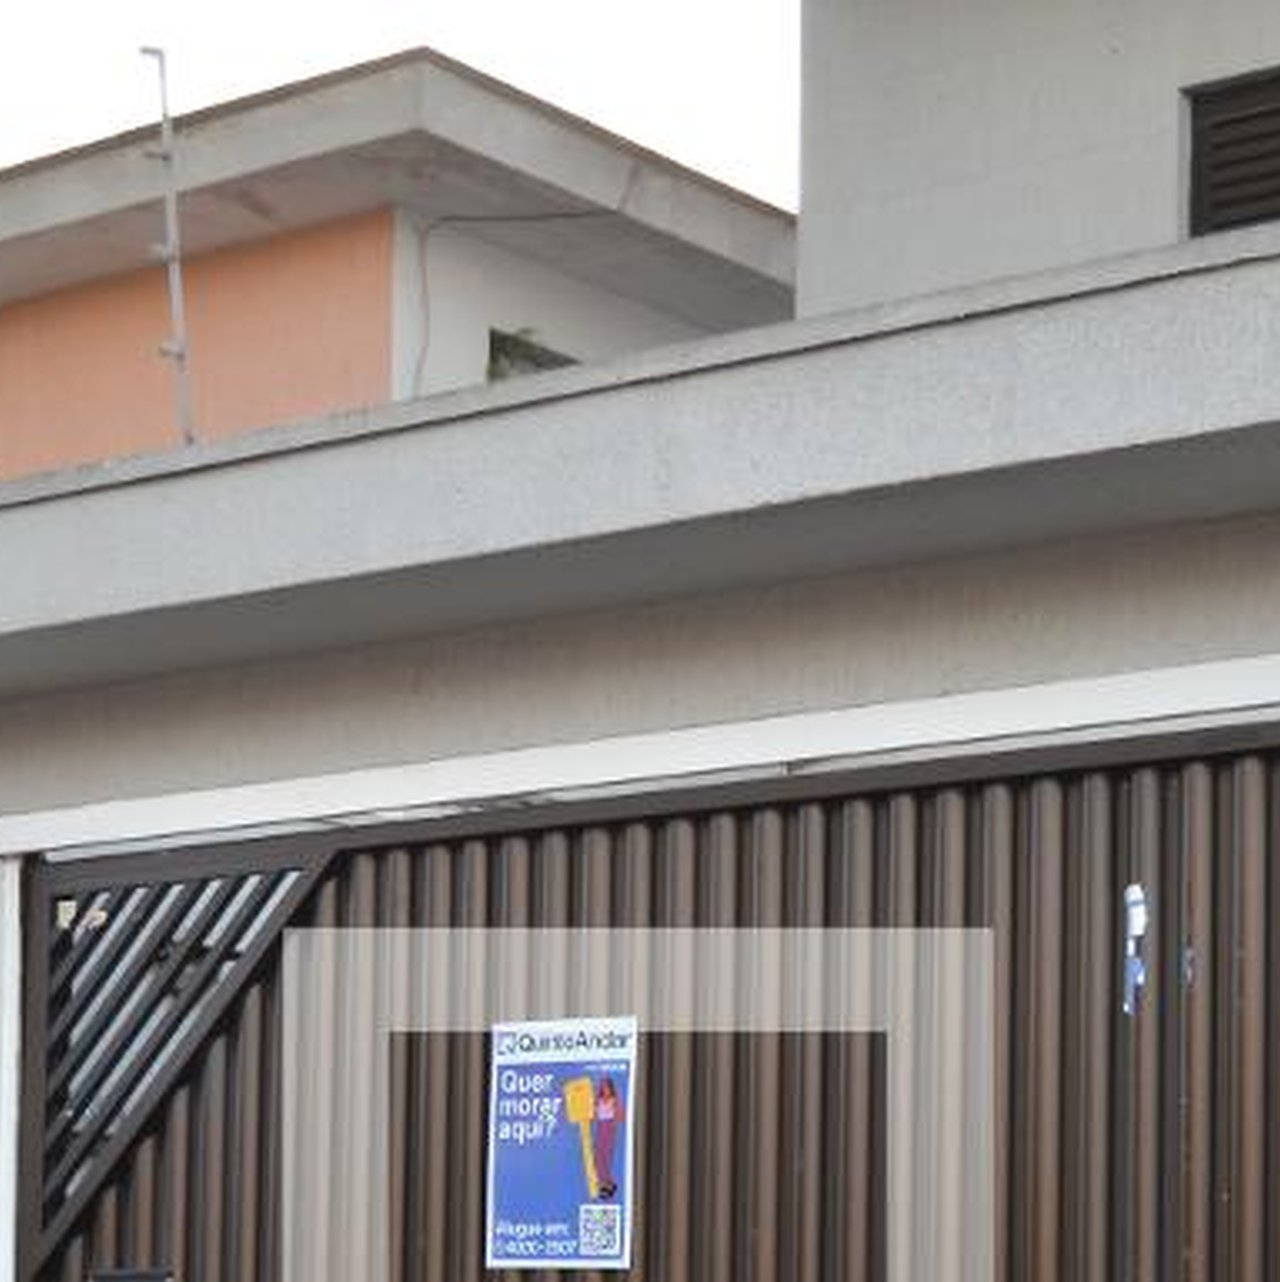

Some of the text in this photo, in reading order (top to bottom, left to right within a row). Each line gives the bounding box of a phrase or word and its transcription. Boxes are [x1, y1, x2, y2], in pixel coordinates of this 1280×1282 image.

[518, 1029, 628, 1053] QuintoAndar
[500, 1068, 555, 1094] Quer
[498, 1097, 562, 1117] morar
[498, 1114, 557, 1146] aqui?
